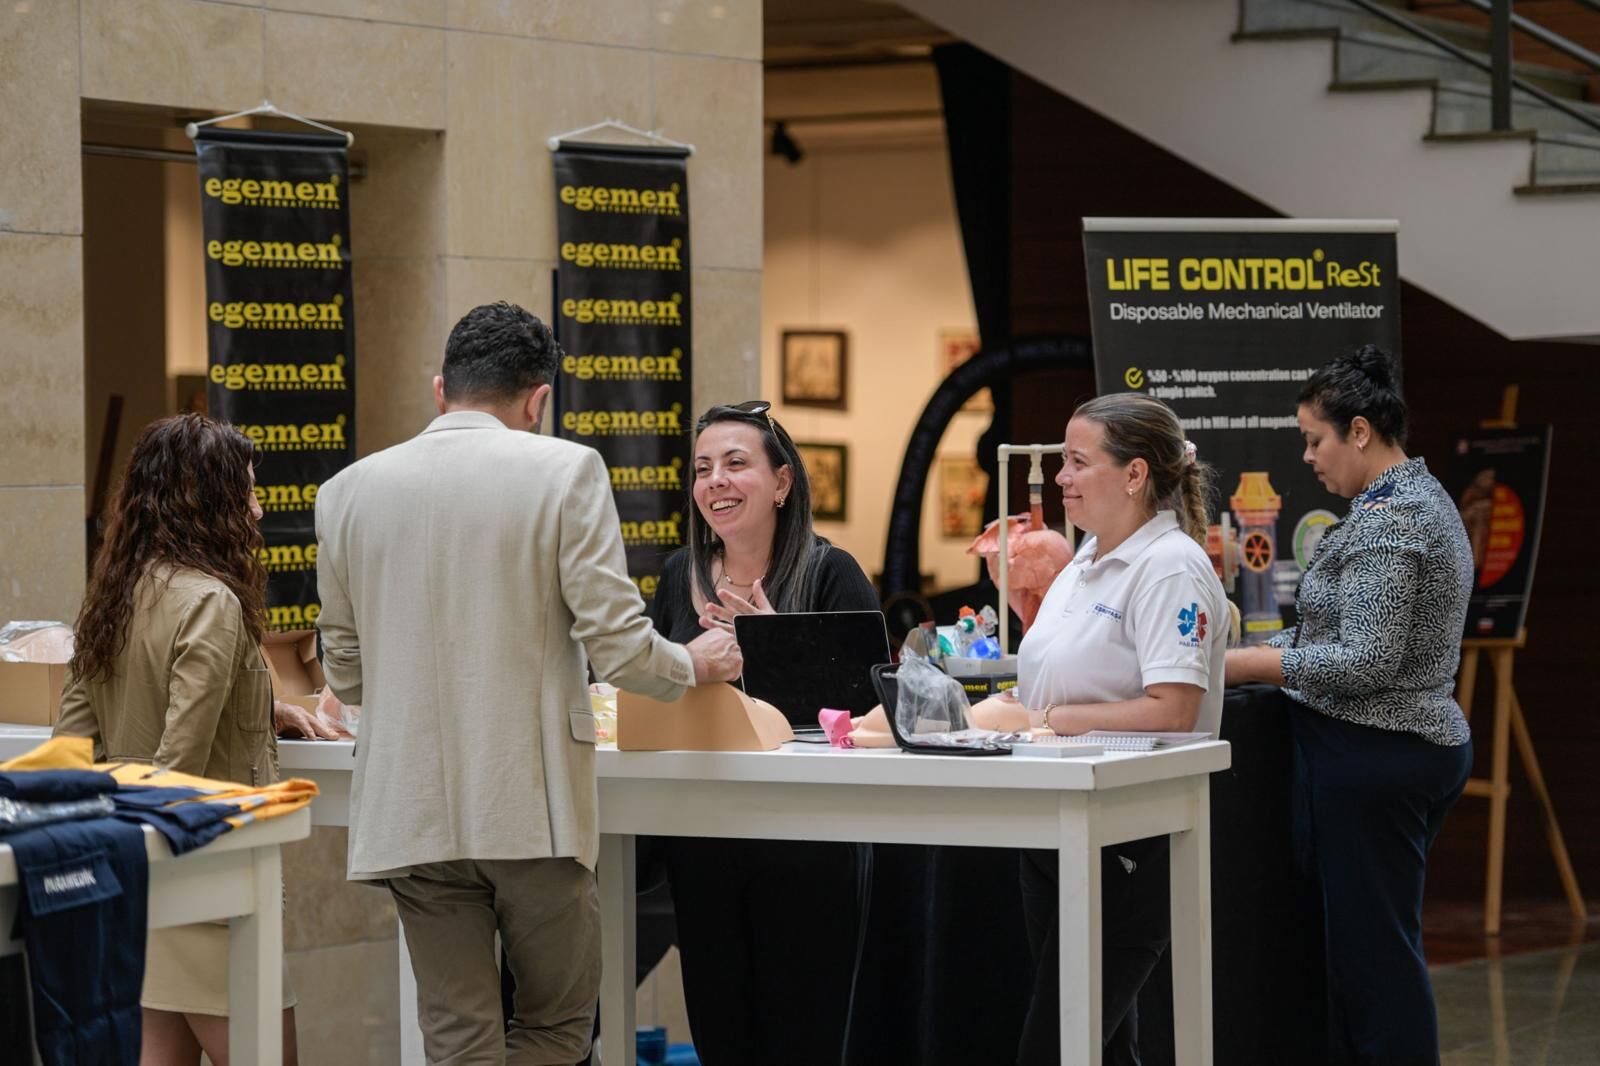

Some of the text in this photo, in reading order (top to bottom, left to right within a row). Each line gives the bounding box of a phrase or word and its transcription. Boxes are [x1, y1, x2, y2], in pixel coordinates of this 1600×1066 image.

[205, 177, 338, 204] egemen
[560, 185, 679, 210] egemen
[207, 239, 342, 266] egemen
[561, 242, 679, 266] egemen
[1106, 256, 1381, 290] LIFE CONTROL ReSt
[209, 301, 343, 328] egemen
[562, 298, 680, 323] egemen
[1110, 301, 1384, 324] Disposable Mechanical Ventilator
[210, 363, 344, 390] egemen
[562, 354, 680, 379] egemen
[239, 423, 344, 444] emen
[562, 410, 680, 436] egemen
[609, 465, 679, 484] men
[253, 483, 319, 504] eme
[621, 519, 679, 538] men
